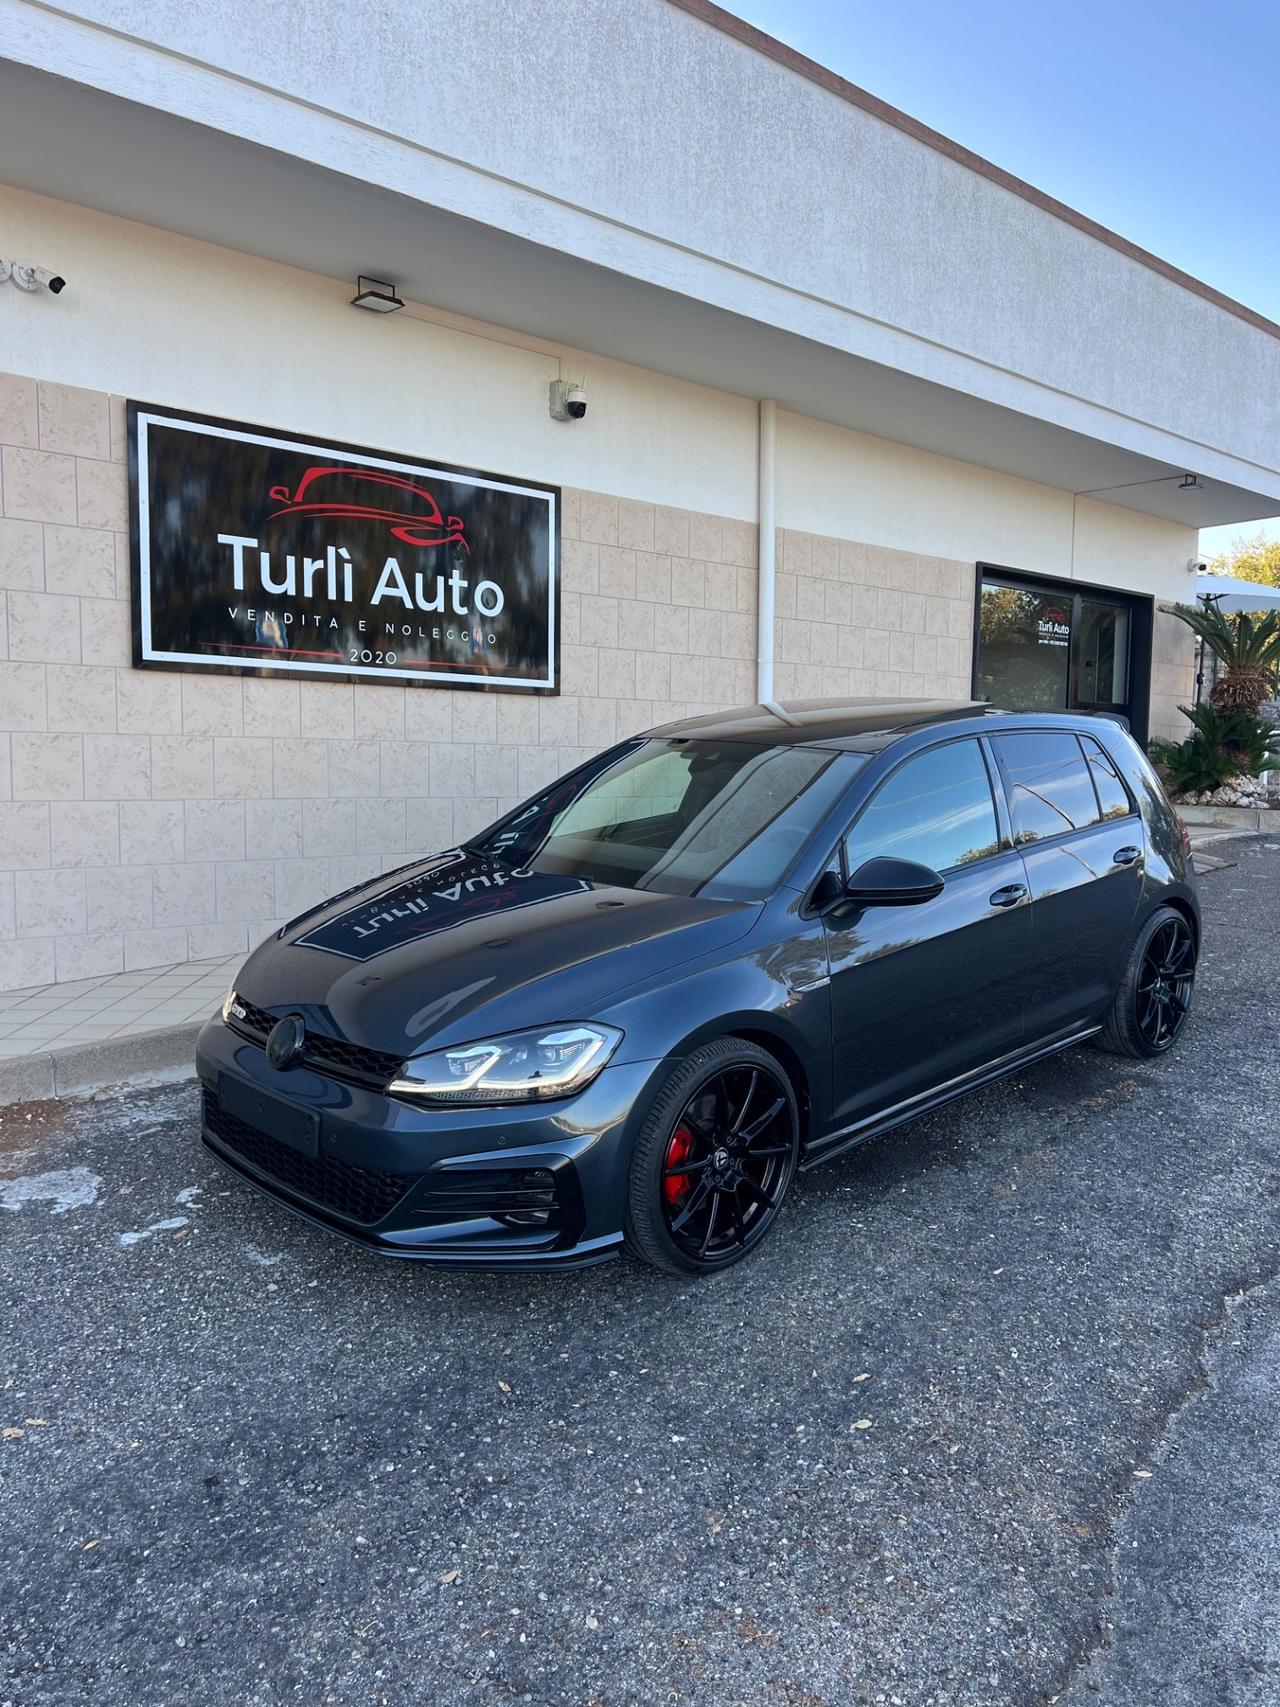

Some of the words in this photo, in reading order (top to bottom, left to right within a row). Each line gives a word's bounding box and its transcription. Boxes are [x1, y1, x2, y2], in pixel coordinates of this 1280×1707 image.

[217, 533, 353, 602] Turlì
[370, 557, 505, 617] Auto
[228, 607, 338, 629] VENDITA
[358, 620, 366, 631] E
[386, 623, 496, 644] NOLEGGIO
[1053, 623, 1070, 634] Auto
[350, 649, 397, 665] 2020
